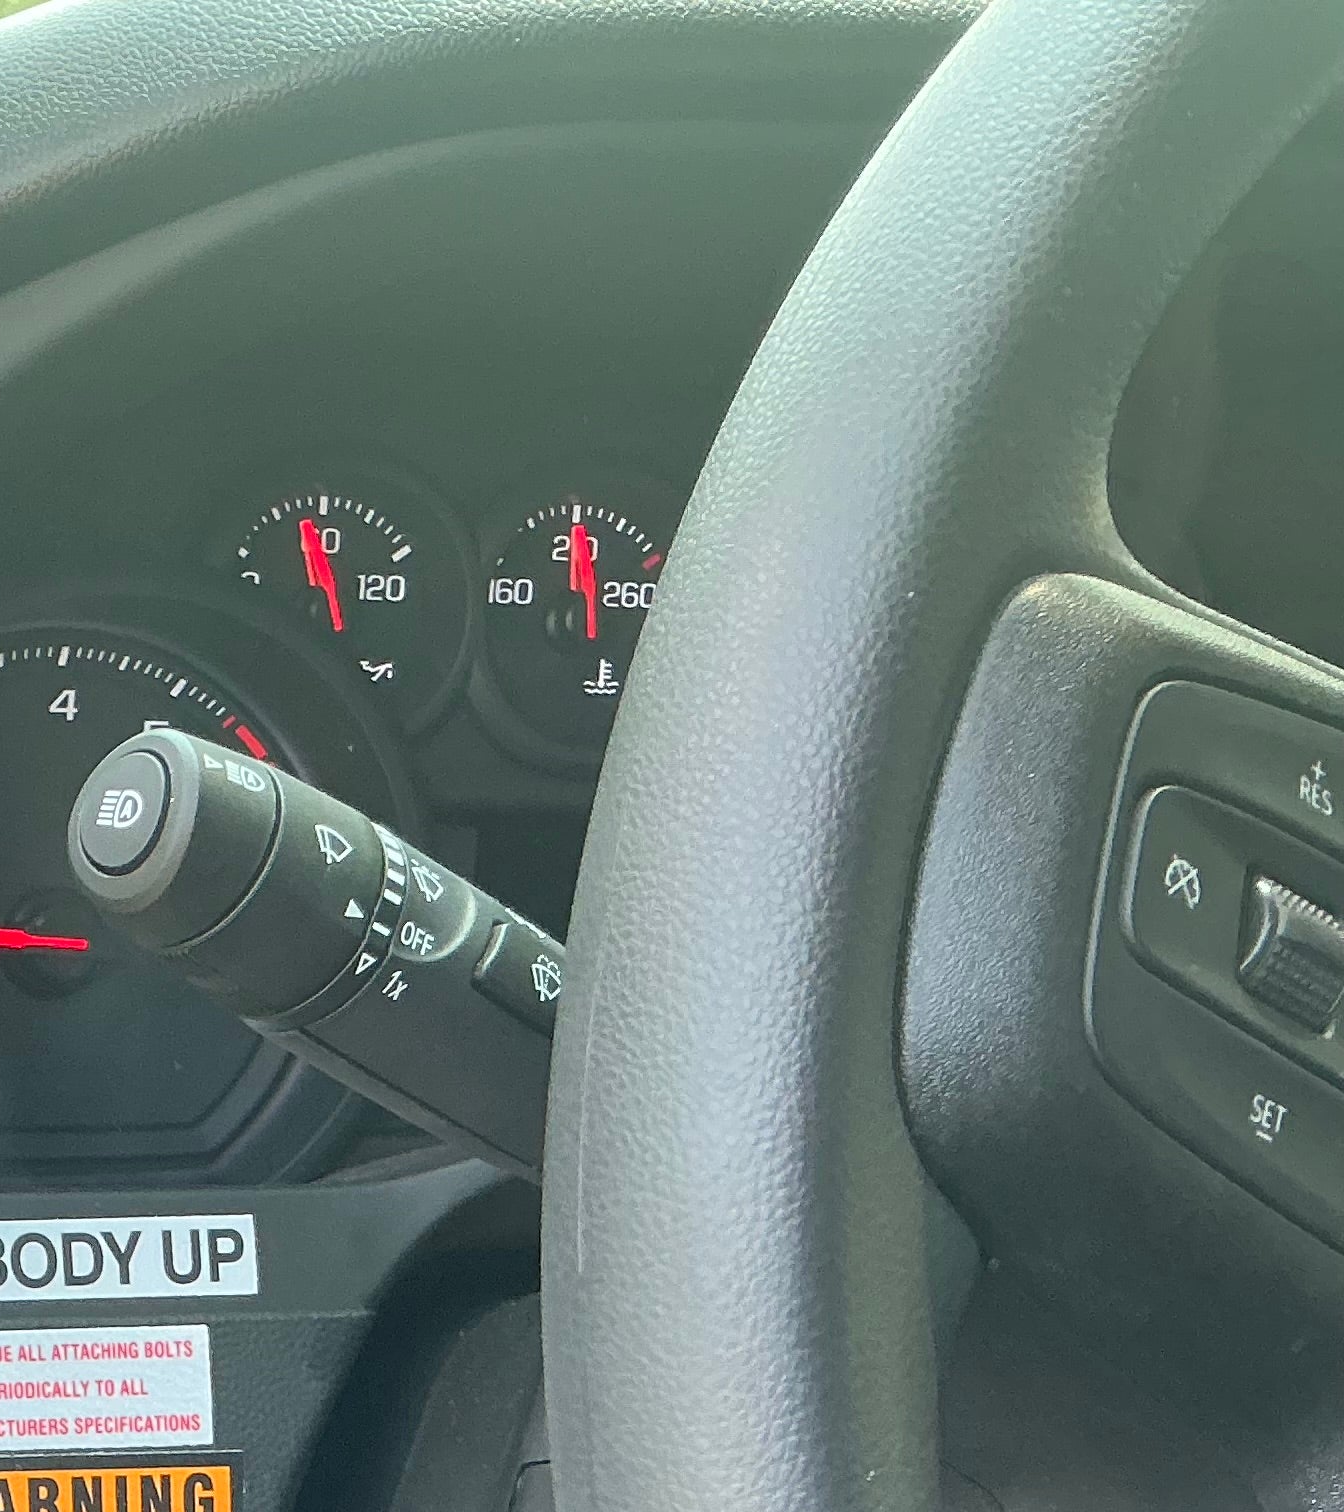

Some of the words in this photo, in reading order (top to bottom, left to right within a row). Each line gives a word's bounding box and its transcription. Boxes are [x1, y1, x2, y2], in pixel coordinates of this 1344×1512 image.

[551, 536, 599, 563] 20
[357, 575, 406, 602] 120
[488, 578, 534, 606] 160
[602, 582, 657, 610] 260
[48, 688, 79, 722] 4
[1299, 776, 1333, 816] RES
[400, 922, 434, 955] OFF
[1250, 1094, 1287, 1134] SET
[162, 1228, 245, 1285] UP
[17, 1345, 46, 1362] ALL
[52, 1342, 139, 1361] ATTACHING
[144, 1340, 193, 1358] BOLTS
[95, 1379, 113, 1397] TO
[120, 1378, 148, 1396] ALL
[74, 1414, 200, 1435] SPECIFICATIONS
